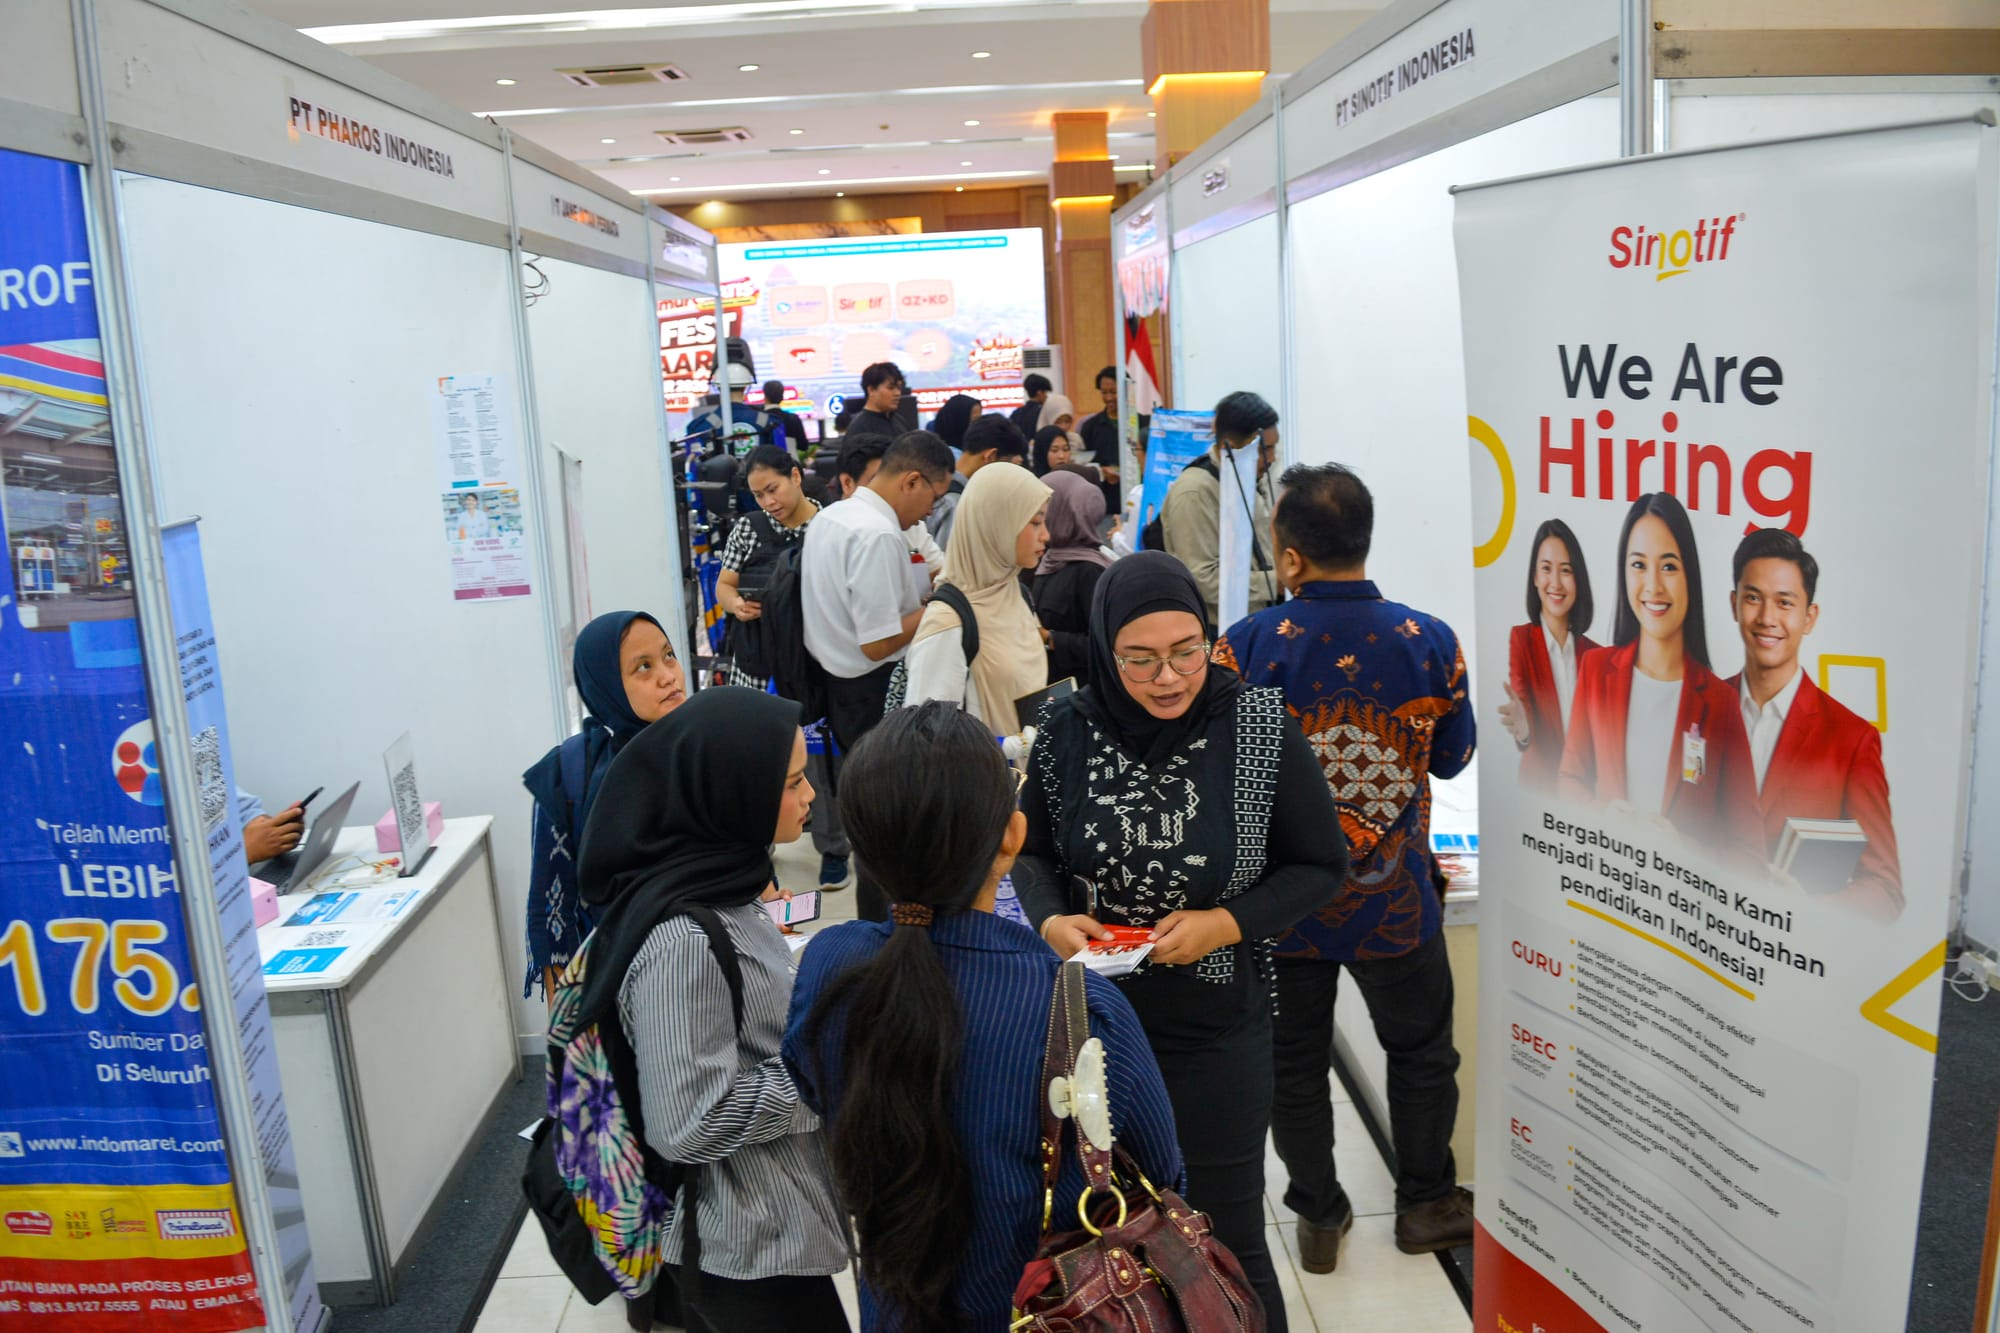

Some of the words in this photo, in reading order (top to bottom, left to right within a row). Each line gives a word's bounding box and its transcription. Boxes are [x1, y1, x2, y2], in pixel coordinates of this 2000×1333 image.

[1336, 97, 1349, 126] PT
[1351, 70, 1394, 118] SINOTIF
[1398, 28, 1475, 93] INDONESIA
[289, 97, 312, 131] PT
[316, 107, 381, 155] PHAROS
[384, 132, 454, 179] INDONESIA
[660, 311, 738, 350] FEST
[1557, 343, 1654, 400] We
[1670, 342, 1783, 406] Are
[1539, 409, 1813, 539] Hiring
[50, 823, 105, 844] Telah
[59, 861, 180, 898] LEBIH
[1543, 812, 1648, 867] Bergabung
[1653, 851, 1728, 905] bersama
[1734, 892, 1793, 934] Kami
[1522, 831, 1594, 873] menjadi
[1600, 858, 1662, 901] bagian
[1668, 890, 1702, 921] dari
[1706, 911, 1825, 978] perubahan
[1560, 874, 1665, 931] pendidikan
[1671, 918, 1765, 986] Indonesia!
[1511, 940, 1562, 979] GURU
[88, 1030, 165, 1052] Sumber
[1511, 1022, 1557, 1061] SPEC
[96, 1062, 122, 1082] Di
[124, 1062, 210, 1084] Seluruh
[26, 1135, 225, 1153] www.indomaret.com
[1510, 1117, 1533, 1144] EC
[35, 1282, 77, 1294] BIAYA
[78, 1282, 120, 1294] PADA
[121, 1279, 183, 1293] PROSES
[183, 1272, 253, 1292] SELEKSI
[149, 1299, 187, 1310] ATAU
[193, 1294, 243, 1310] EMAIL
